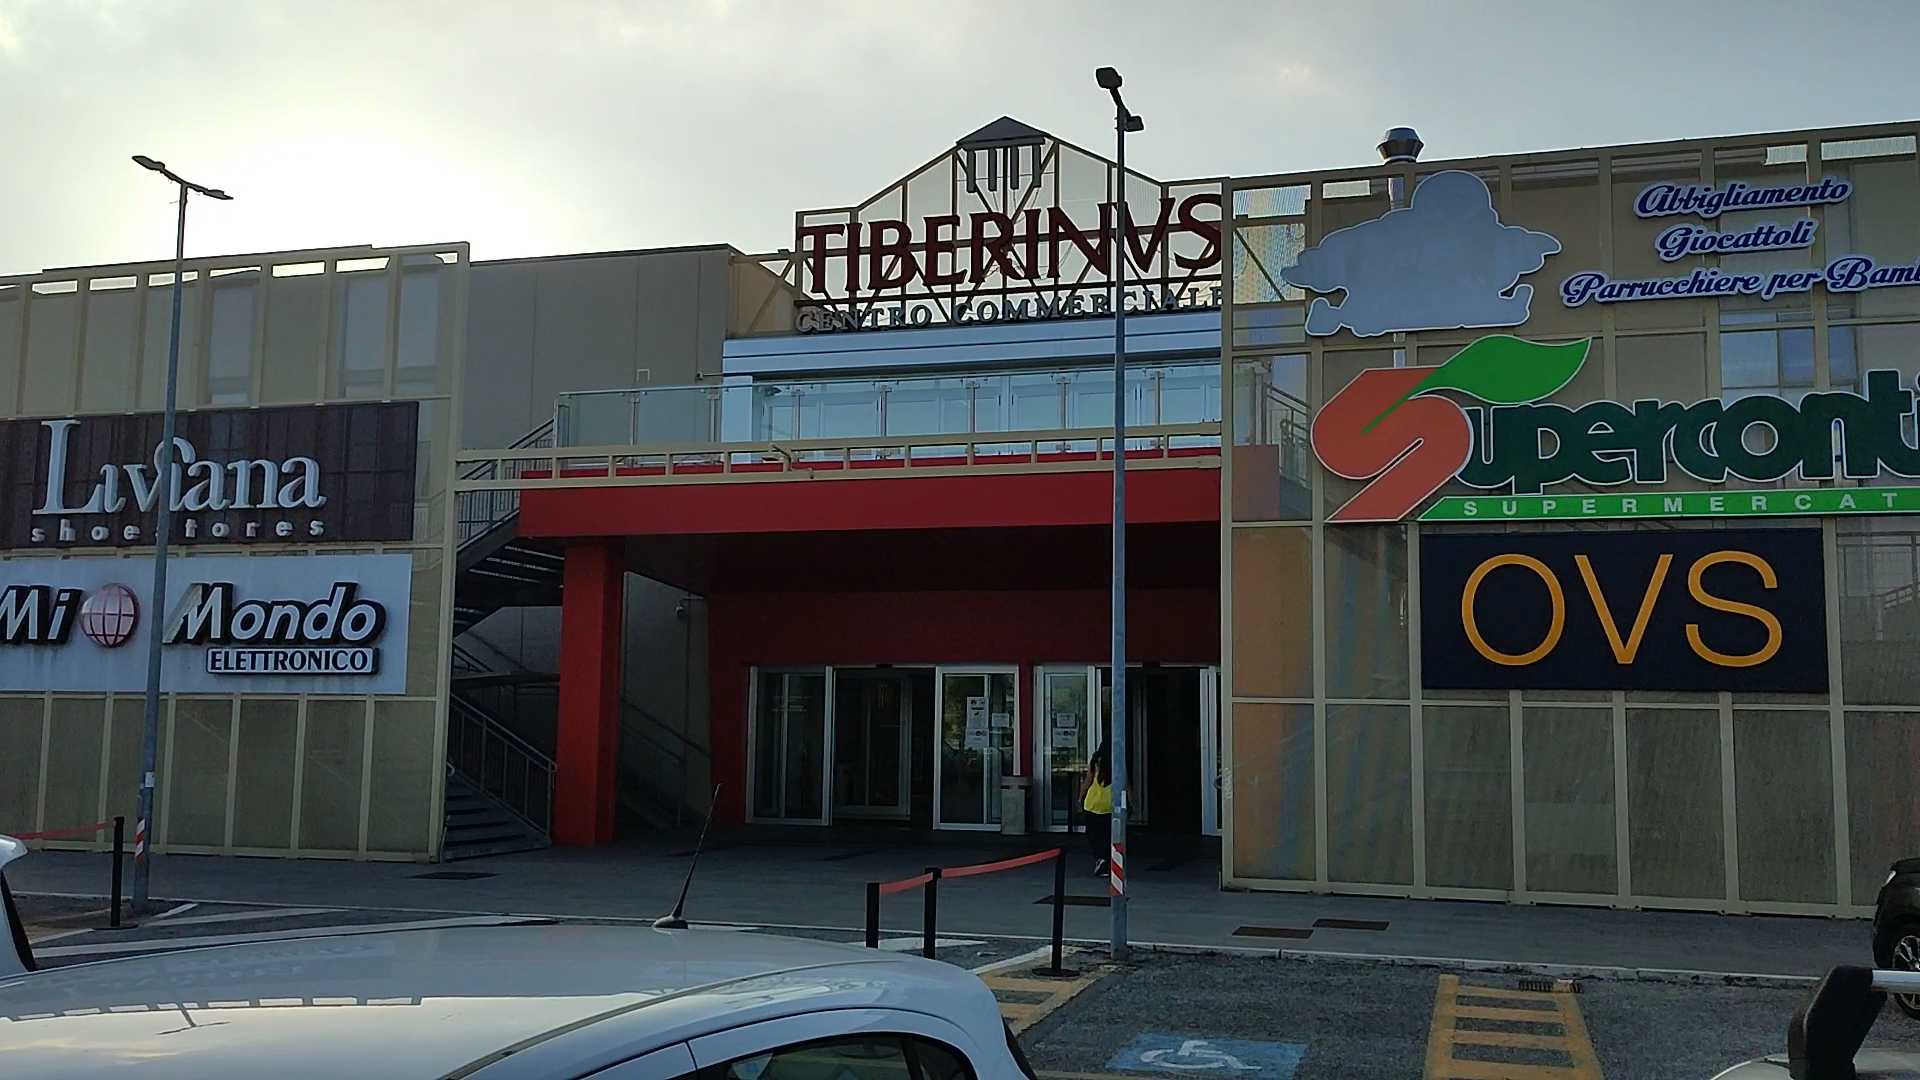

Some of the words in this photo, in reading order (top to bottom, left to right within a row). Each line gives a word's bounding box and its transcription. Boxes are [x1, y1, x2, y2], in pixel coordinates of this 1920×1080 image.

[1637, 177, 1850, 215] Abbigliamento
[1658, 220, 1815, 258] Giocattoli
[1563, 267, 1761, 304] Parrucchiere
[1762, 272, 1820, 297] per
[795, 304, 933, 334] CENTRO
[1310, 365, 1920, 524] Supercont
[1463, 492, 1898, 516] SUPERMERCAT
[32, 518, 141, 542] shoe
[155, 518, 325, 540] tores
[162, 582, 383, 643] Mondo
[1461, 550, 1783, 667] OVS
[210, 650, 368, 671] ELETTRONICO
